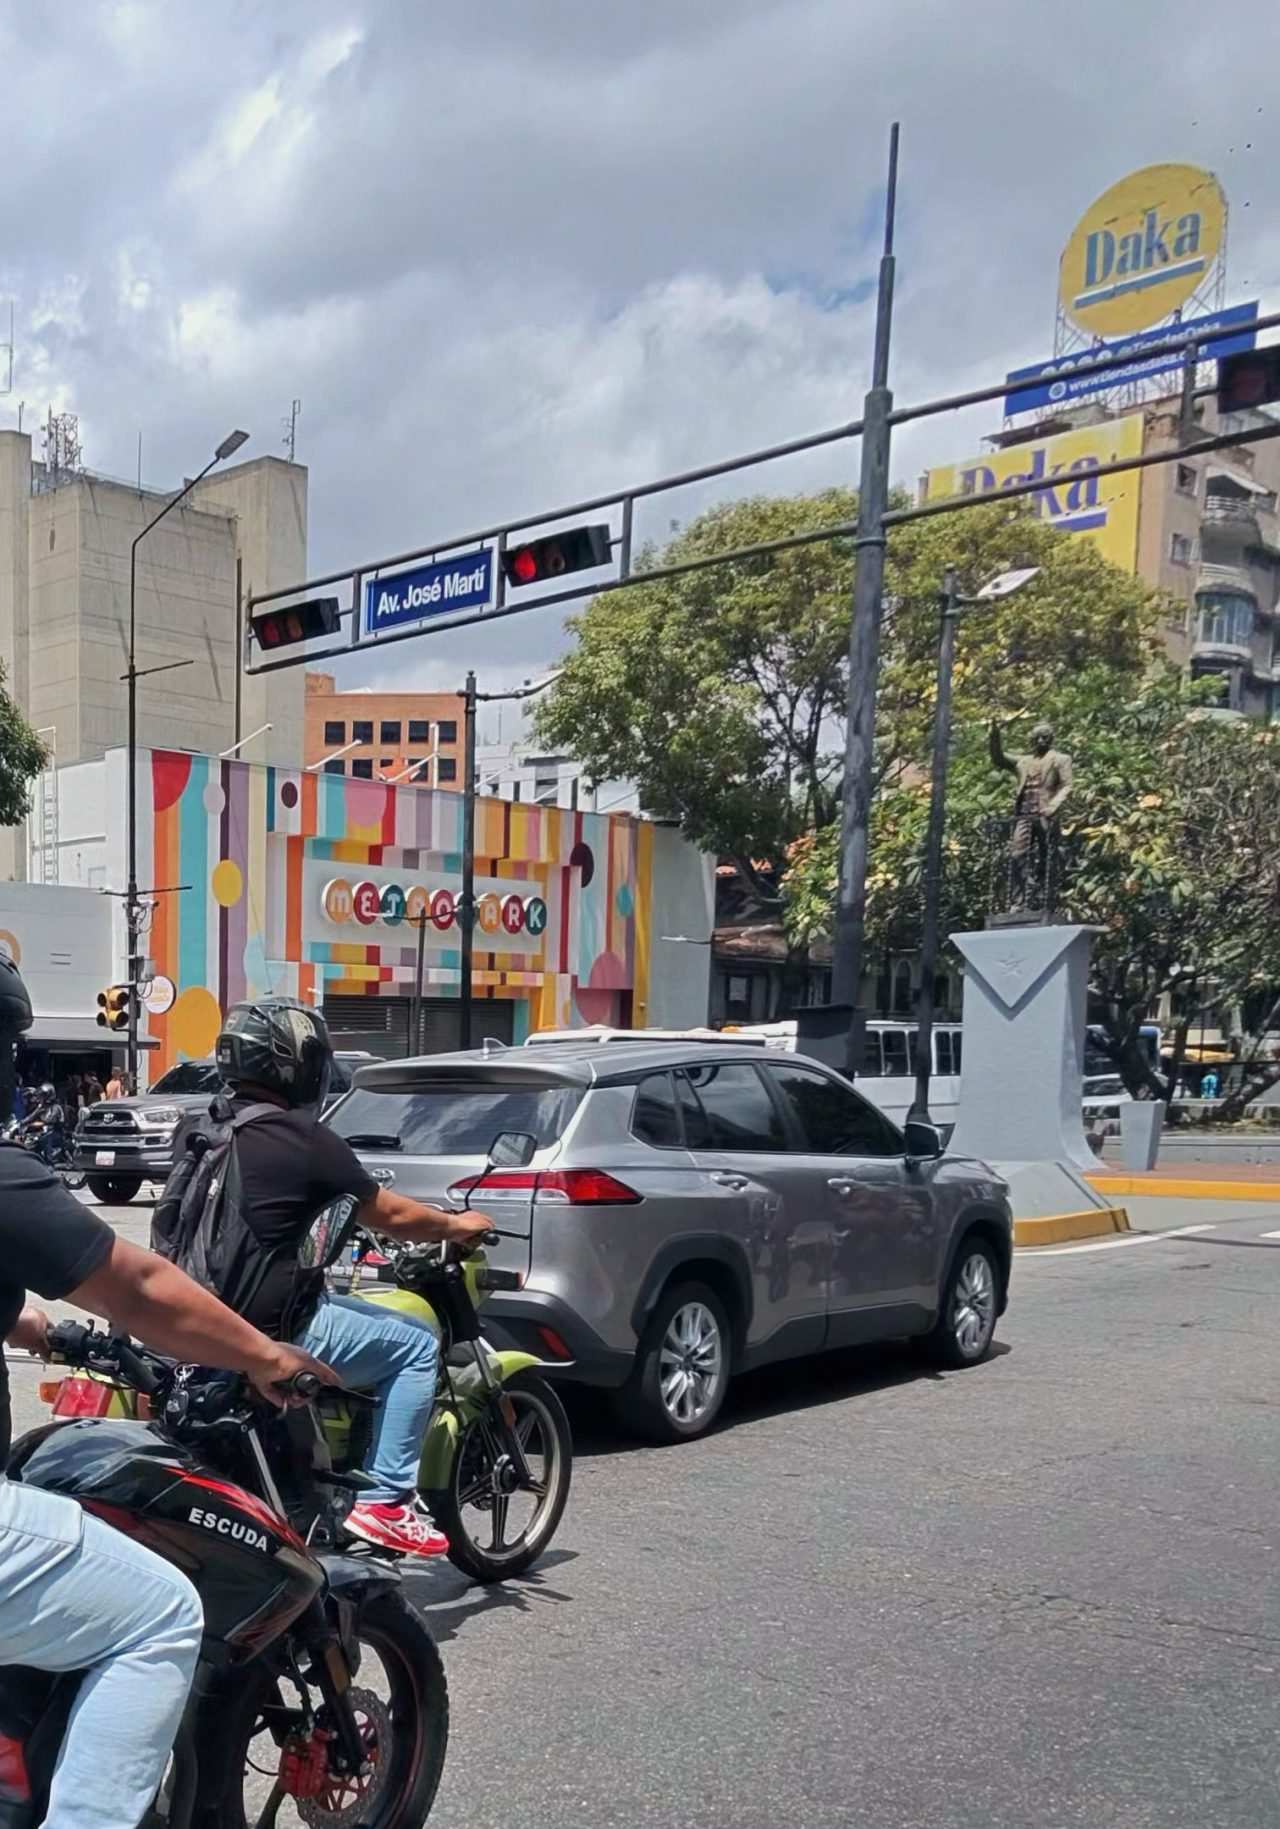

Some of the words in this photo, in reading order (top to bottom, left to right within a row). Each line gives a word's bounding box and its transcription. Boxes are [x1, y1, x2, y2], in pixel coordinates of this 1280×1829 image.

[1086, 212, 1200, 286] Daka
[961, 449, 1099, 519] ka
[377, 592, 400, 616] Av.
[402, 576, 442, 609] José
[443, 564, 486, 599] Martí
[328, 889, 543, 930] METROARK
[188, 1507, 268, 1552] ESCUDA
